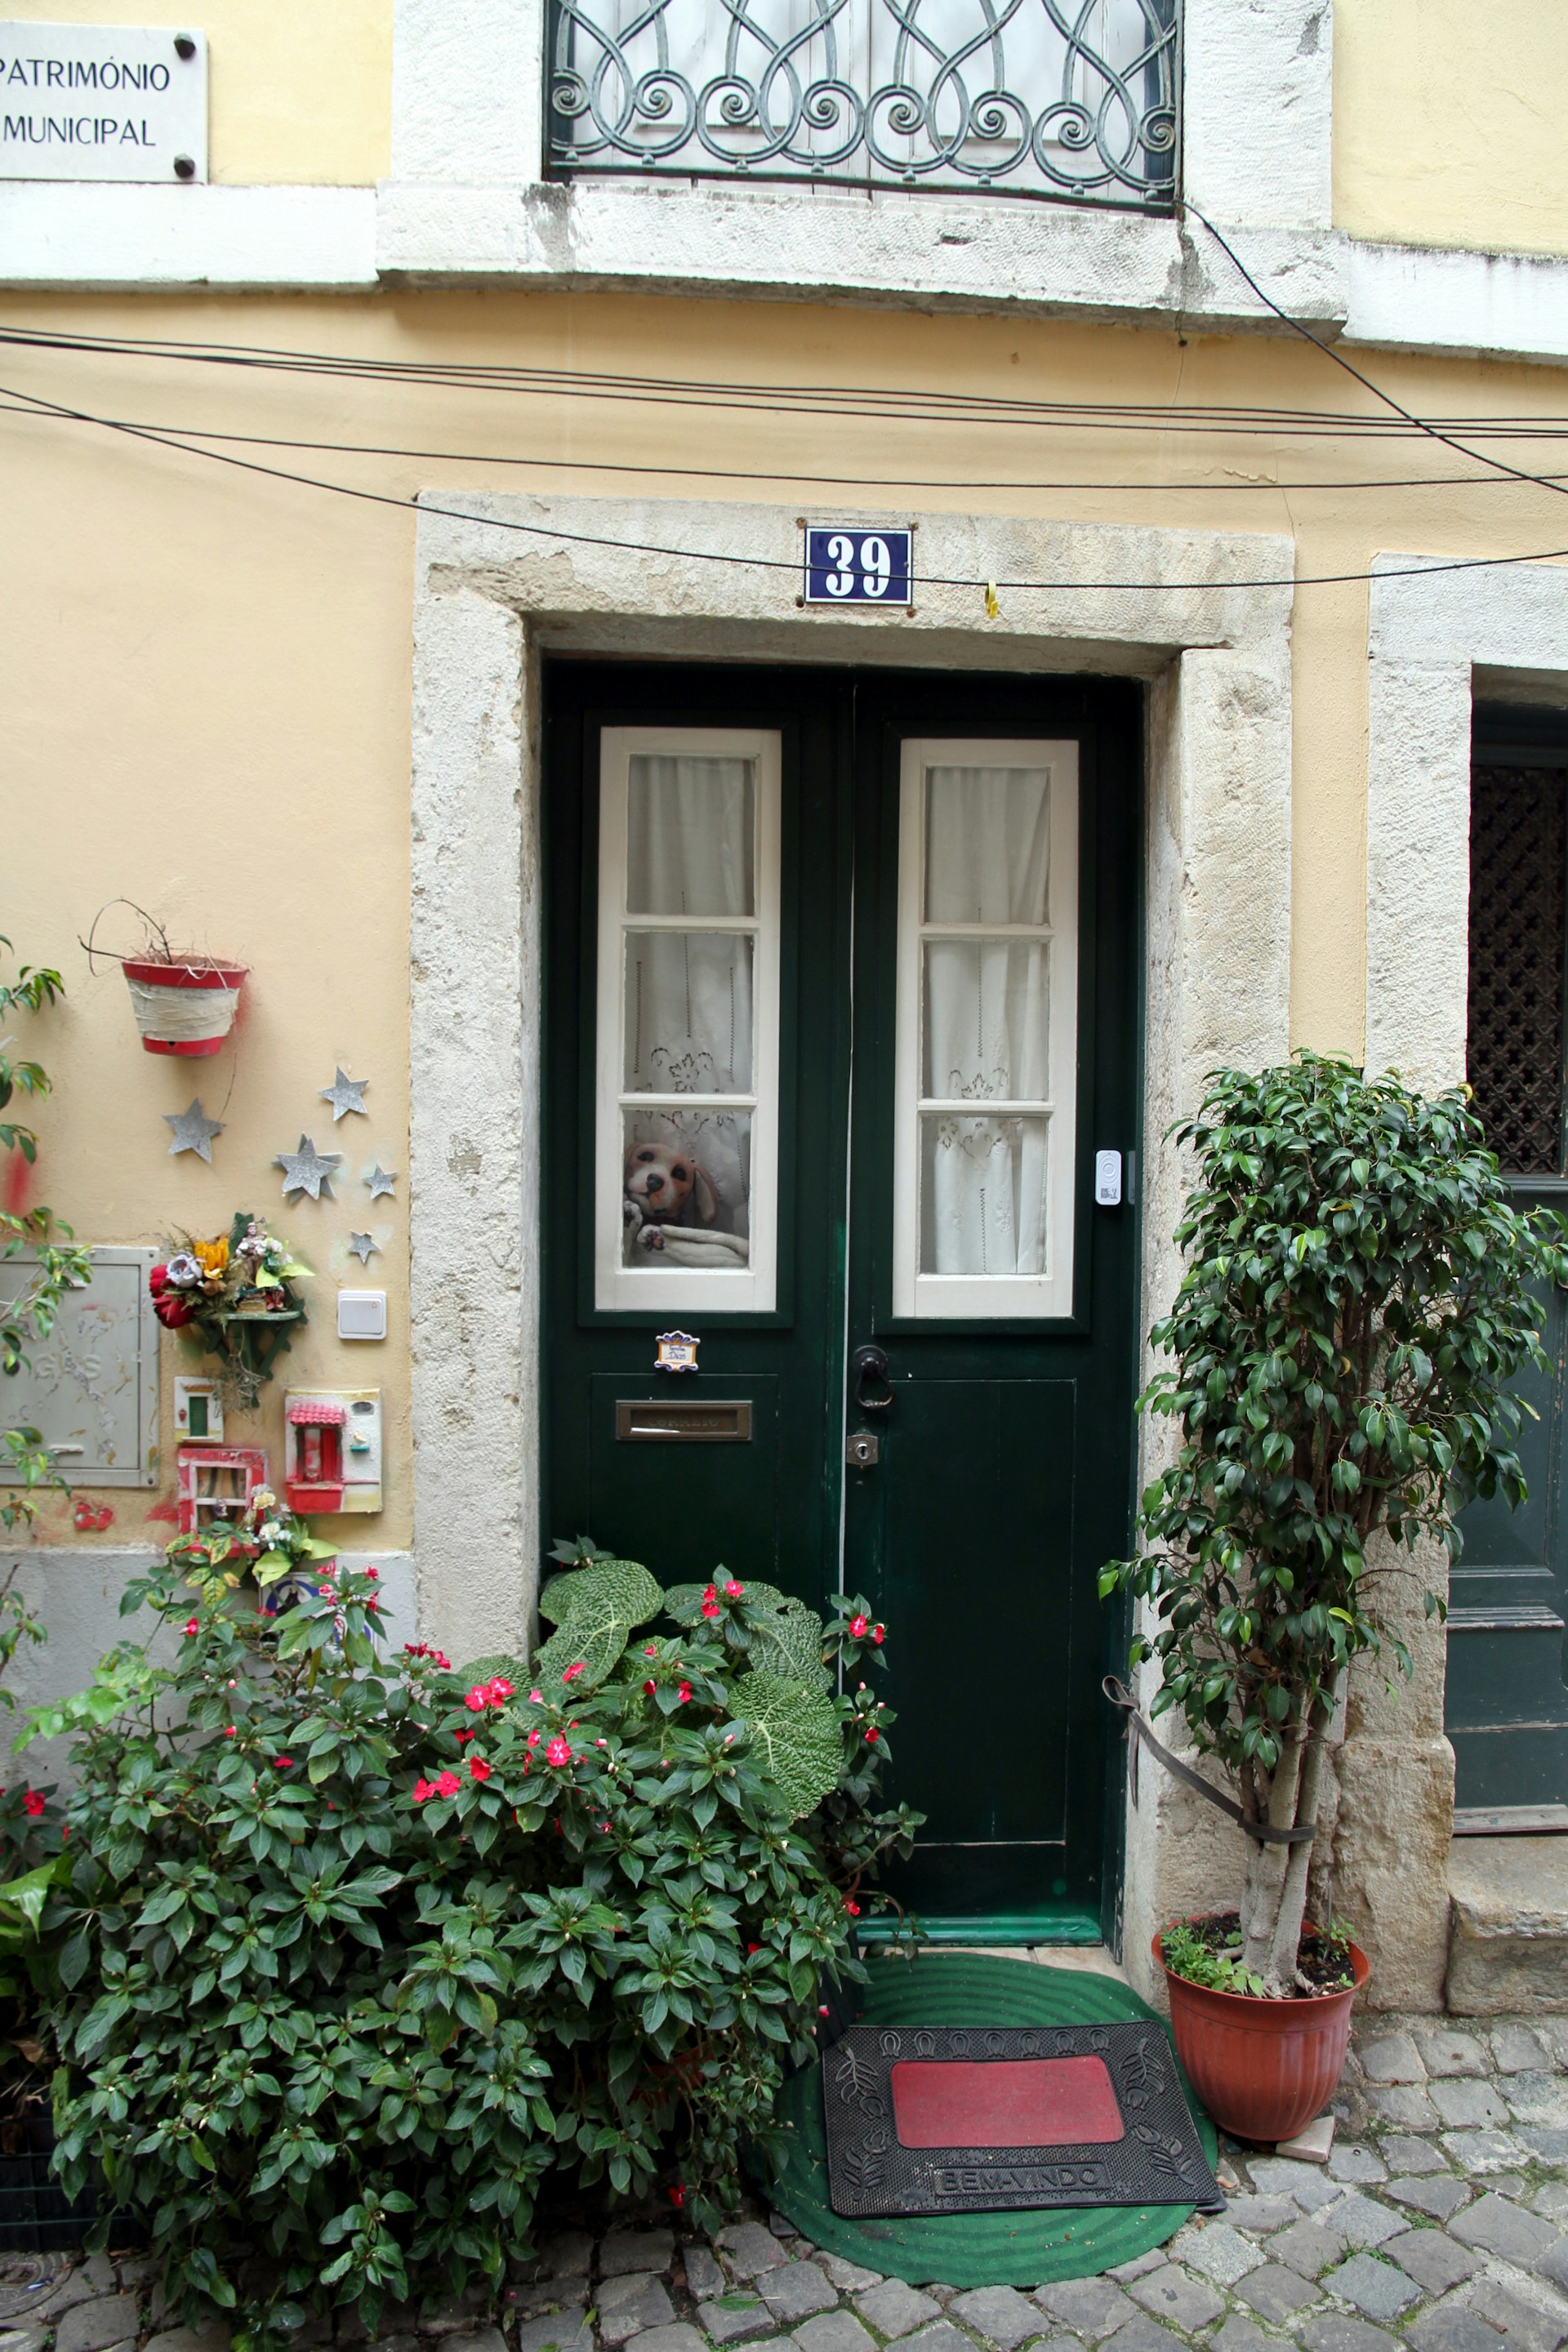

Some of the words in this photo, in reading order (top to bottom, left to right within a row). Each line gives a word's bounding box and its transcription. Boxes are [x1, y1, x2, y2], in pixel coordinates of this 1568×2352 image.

[4, 115, 157, 146] MUNICIPAL
[826, 535, 891, 598] 39
[942, 2167, 1099, 2191] BEM-VINDO
